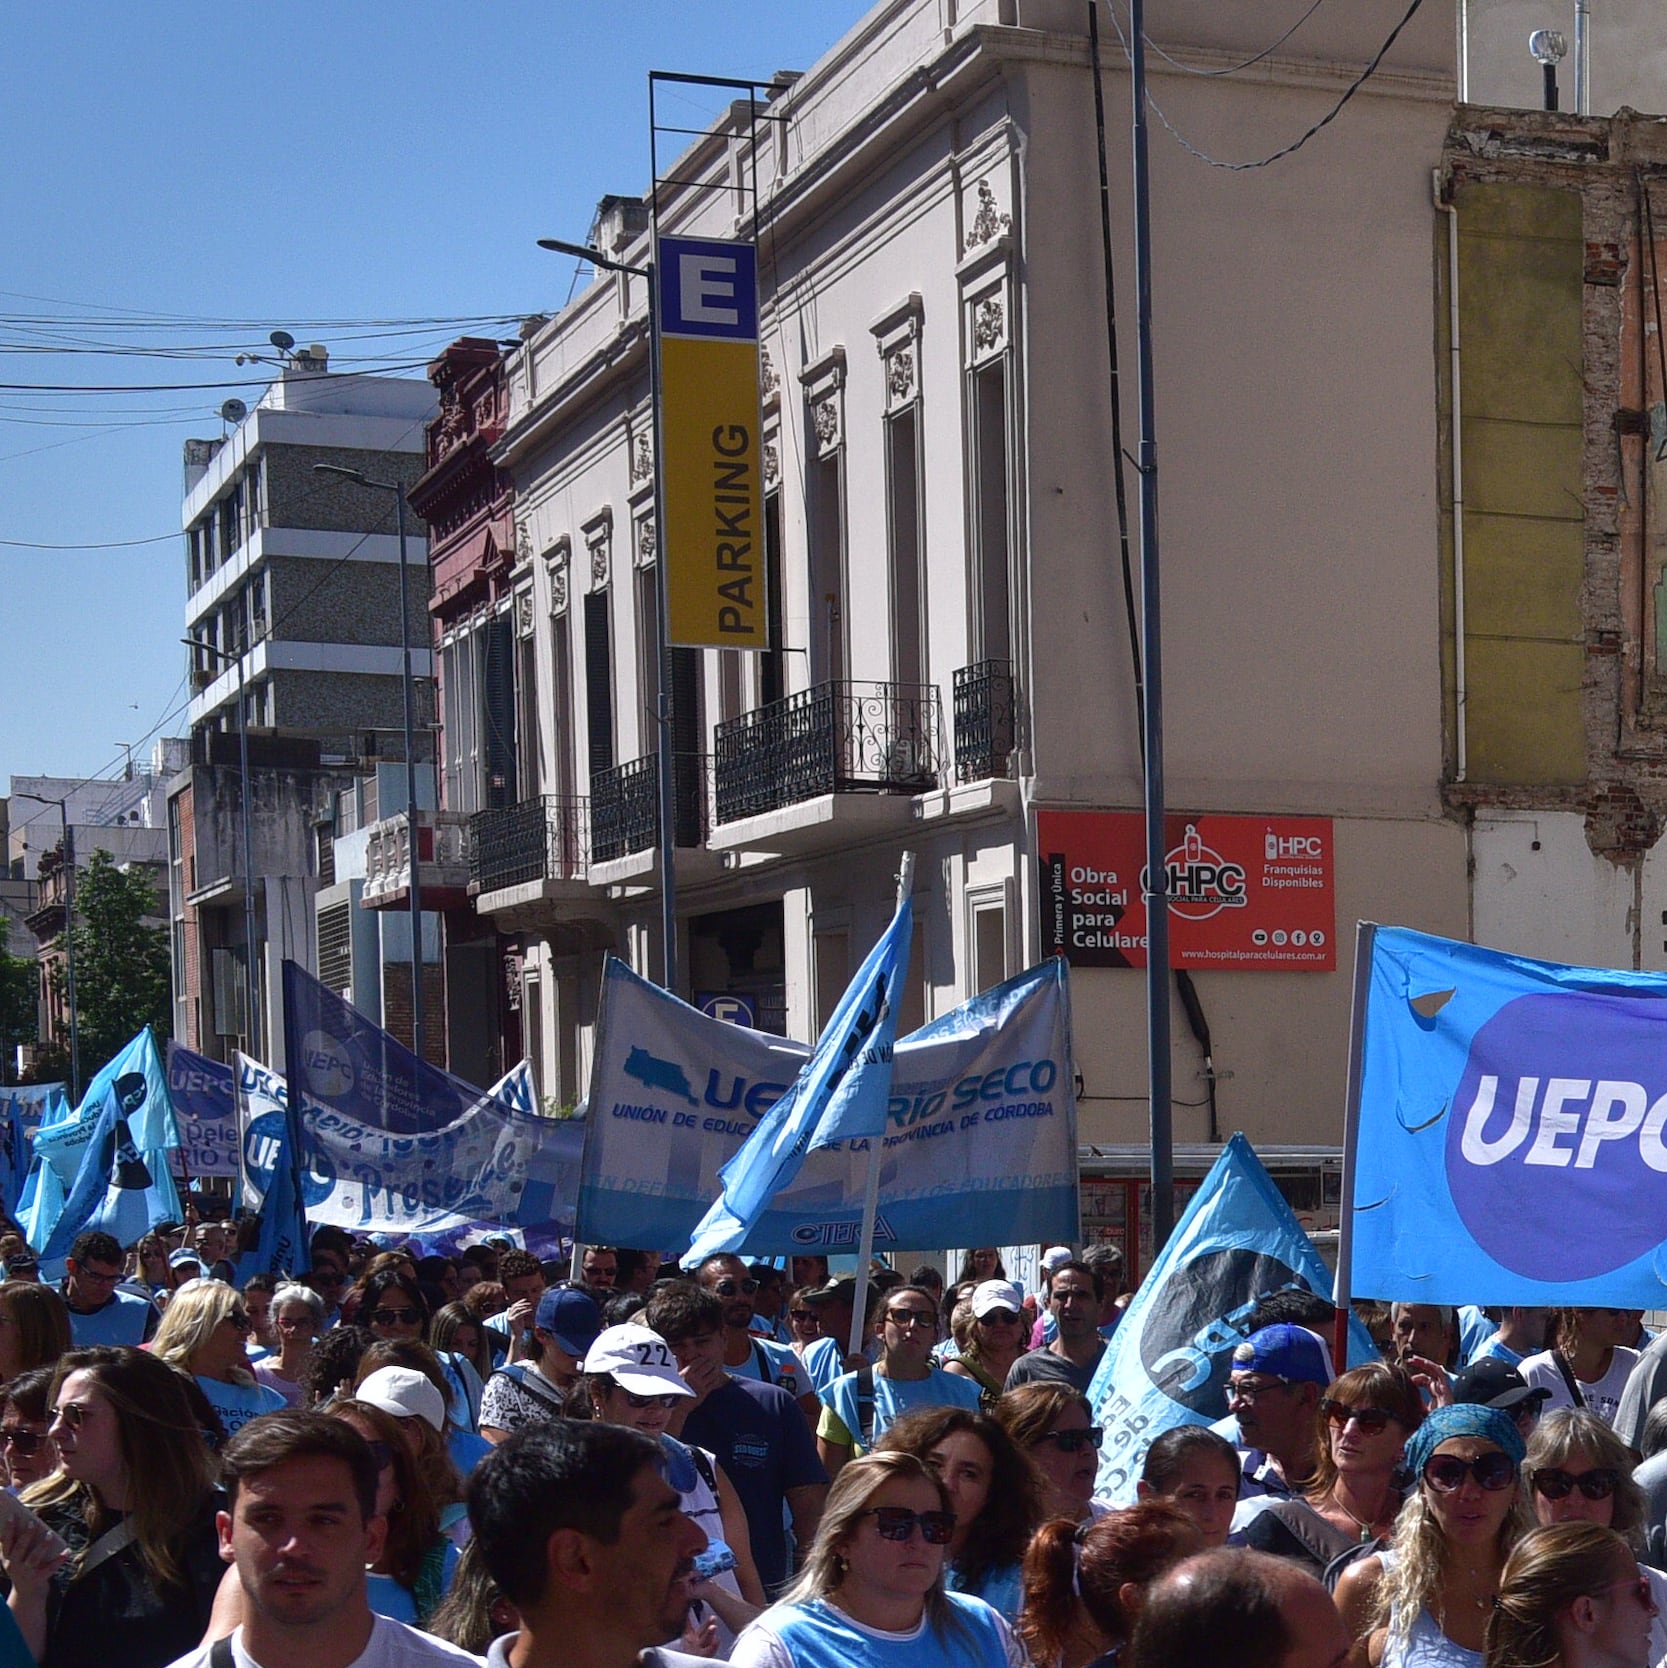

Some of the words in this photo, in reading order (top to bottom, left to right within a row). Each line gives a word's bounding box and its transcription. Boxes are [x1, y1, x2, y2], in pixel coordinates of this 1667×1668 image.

[680, 254, 738, 324] E
[715, 422, 756, 635] PARKING
[1278, 836, 1322, 855] HPC
[1070, 866, 1118, 884] Obra
[1263, 864, 1323, 878] Franquisias
[1262, 877, 1324, 889] Disponibles
[1071, 888, 1128, 906] Social
[1054, 904, 1064, 945] Primera
[1072, 911, 1116, 930] para
[1072, 931, 1149, 949] Celulare
[1181, 949, 1326, 962] www.hospitalparacelulares.com.ar
[951, 1058, 1057, 1111] SECO
[611, 1102, 667, 1125] UNIÓN
[673, 1111, 698, 1129] DE
[849, 1138, 871, 1152] LA
[960, 1113, 982, 1131] DE
[983, 1099, 1055, 1121] CÓRDOBA
[636, 1341, 673, 1367] 22
